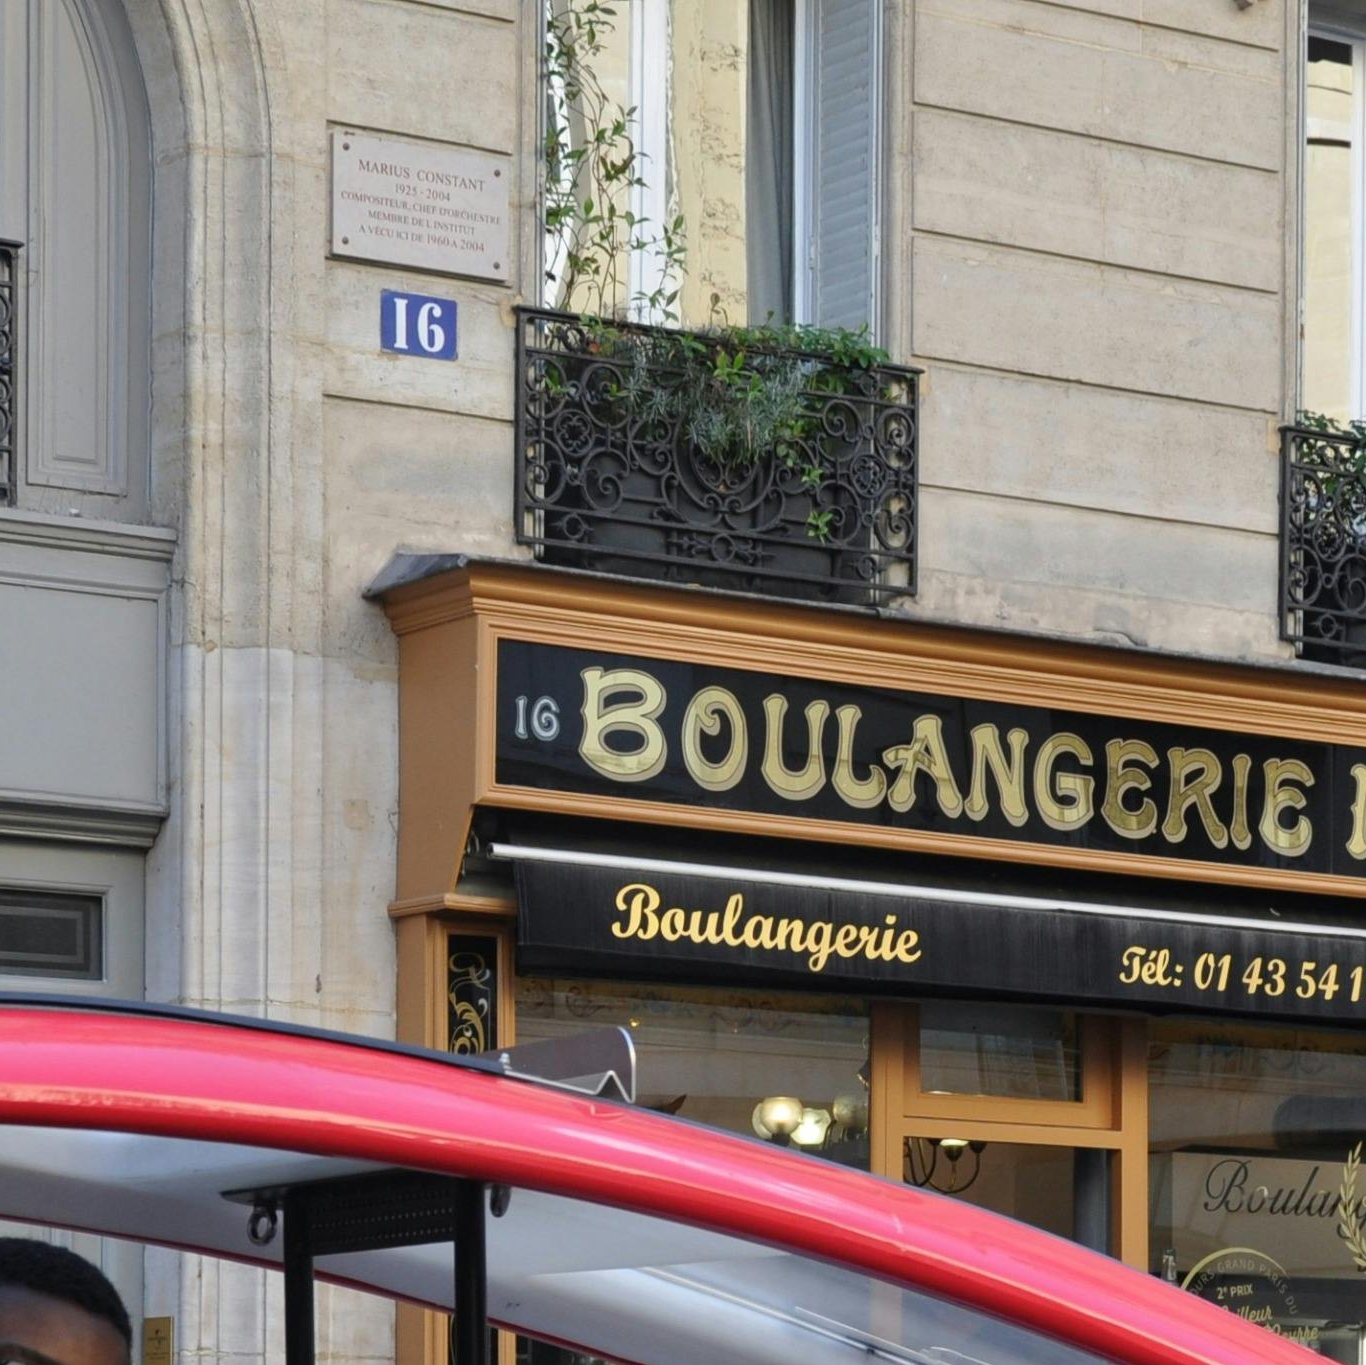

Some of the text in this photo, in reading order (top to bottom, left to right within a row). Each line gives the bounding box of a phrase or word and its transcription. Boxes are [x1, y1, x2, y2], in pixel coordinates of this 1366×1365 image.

[358, 159, 485, 193] MARIUS CONSTANT
[394, 183, 418, 197] 1925
[426, 188, 451, 202] 2004
[367, 209, 410, 225] MEMBRE
[411, 216, 425, 227] DE
[412, 202, 437, 215] CHEF
[358, 225, 366, 234] A
[366, 224, 395, 239] VÉCU
[396, 231, 410, 241] ICI
[411, 232, 425, 242] DE
[426, 233, 450, 247] 1960
[460, 238, 485, 252] 2004
[393, 297, 446, 353] 16
[515, 694, 561, 742] 16
[578, 665, 1316, 858] BOULANGERIE
[611, 883, 922, 973] Boulangerie
[1118, 945, 1184, 989] Tél:
[1193, 950, 1231, 993] 01
[1242, 955, 1288, 996] 43
[1295, 959, 1340, 1001] 54
[1217, 1259, 1255, 1273] GRAND
[1230, 1283, 1254, 1298] PRIX
